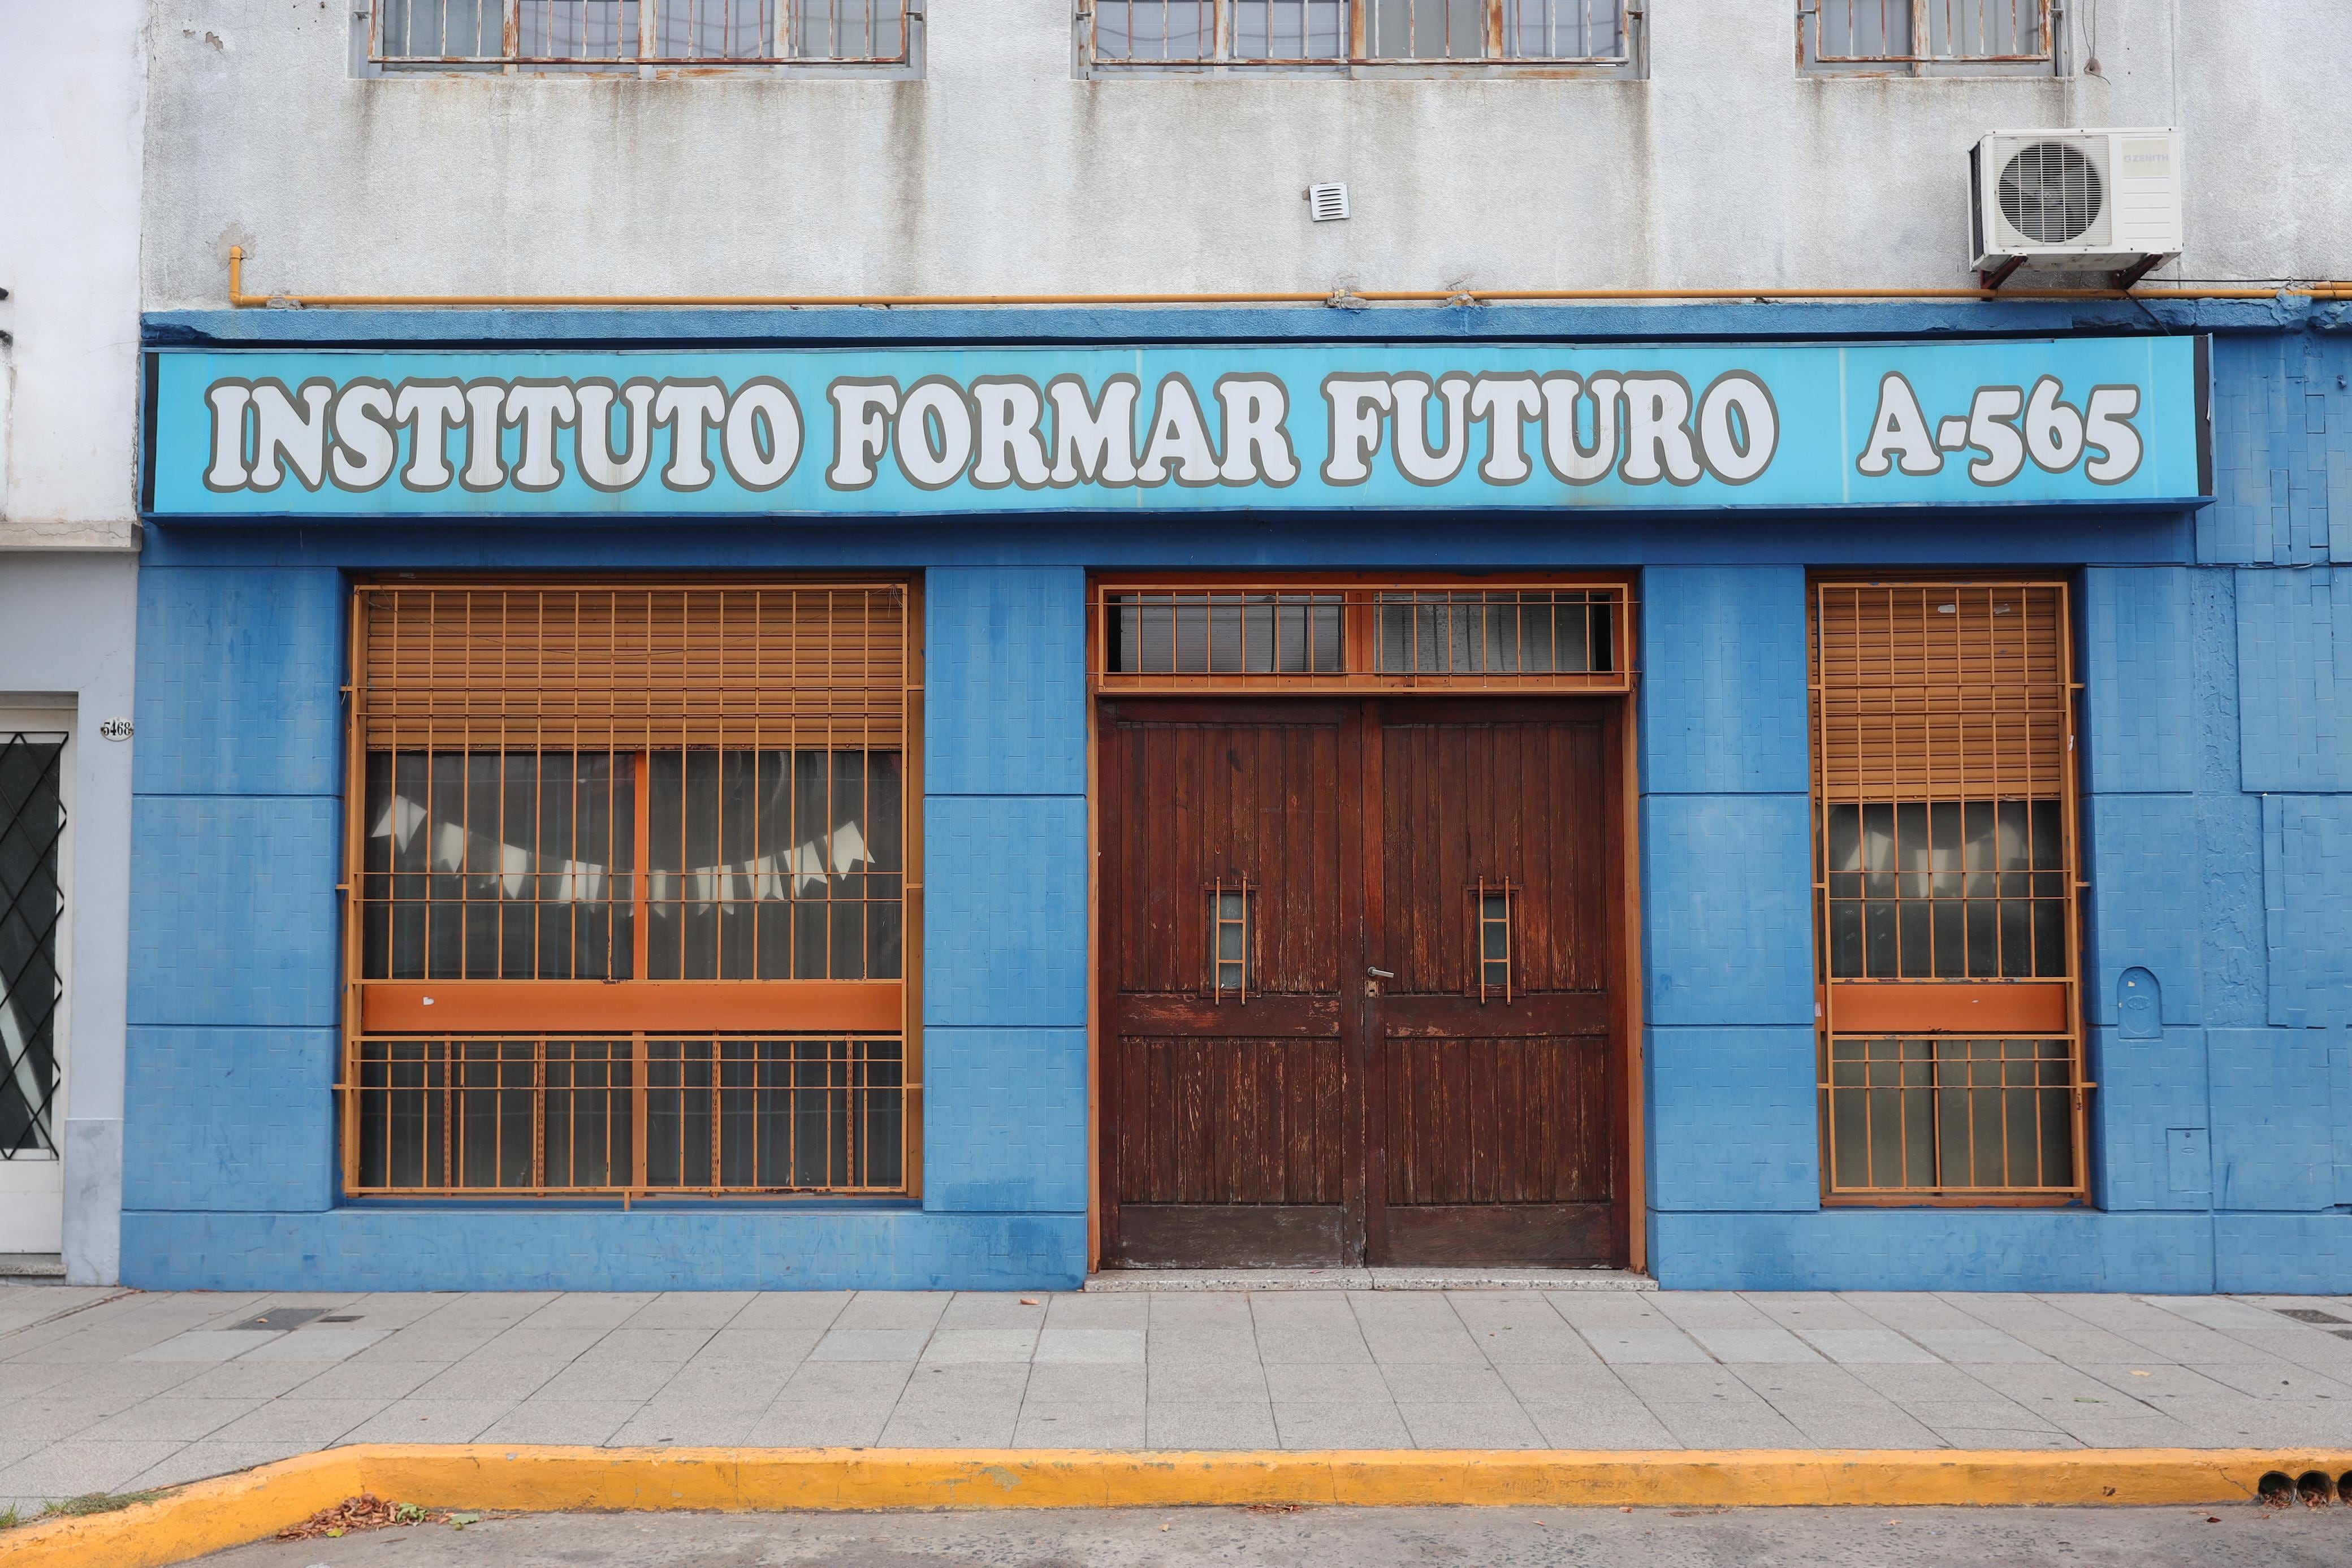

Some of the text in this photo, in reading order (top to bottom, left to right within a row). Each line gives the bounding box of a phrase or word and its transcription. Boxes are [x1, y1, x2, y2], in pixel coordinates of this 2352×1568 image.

[204, 369, 2143, 492] INSTITUTO FORMAR FUTURO A-565
[103, 720, 131, 736] 5468
